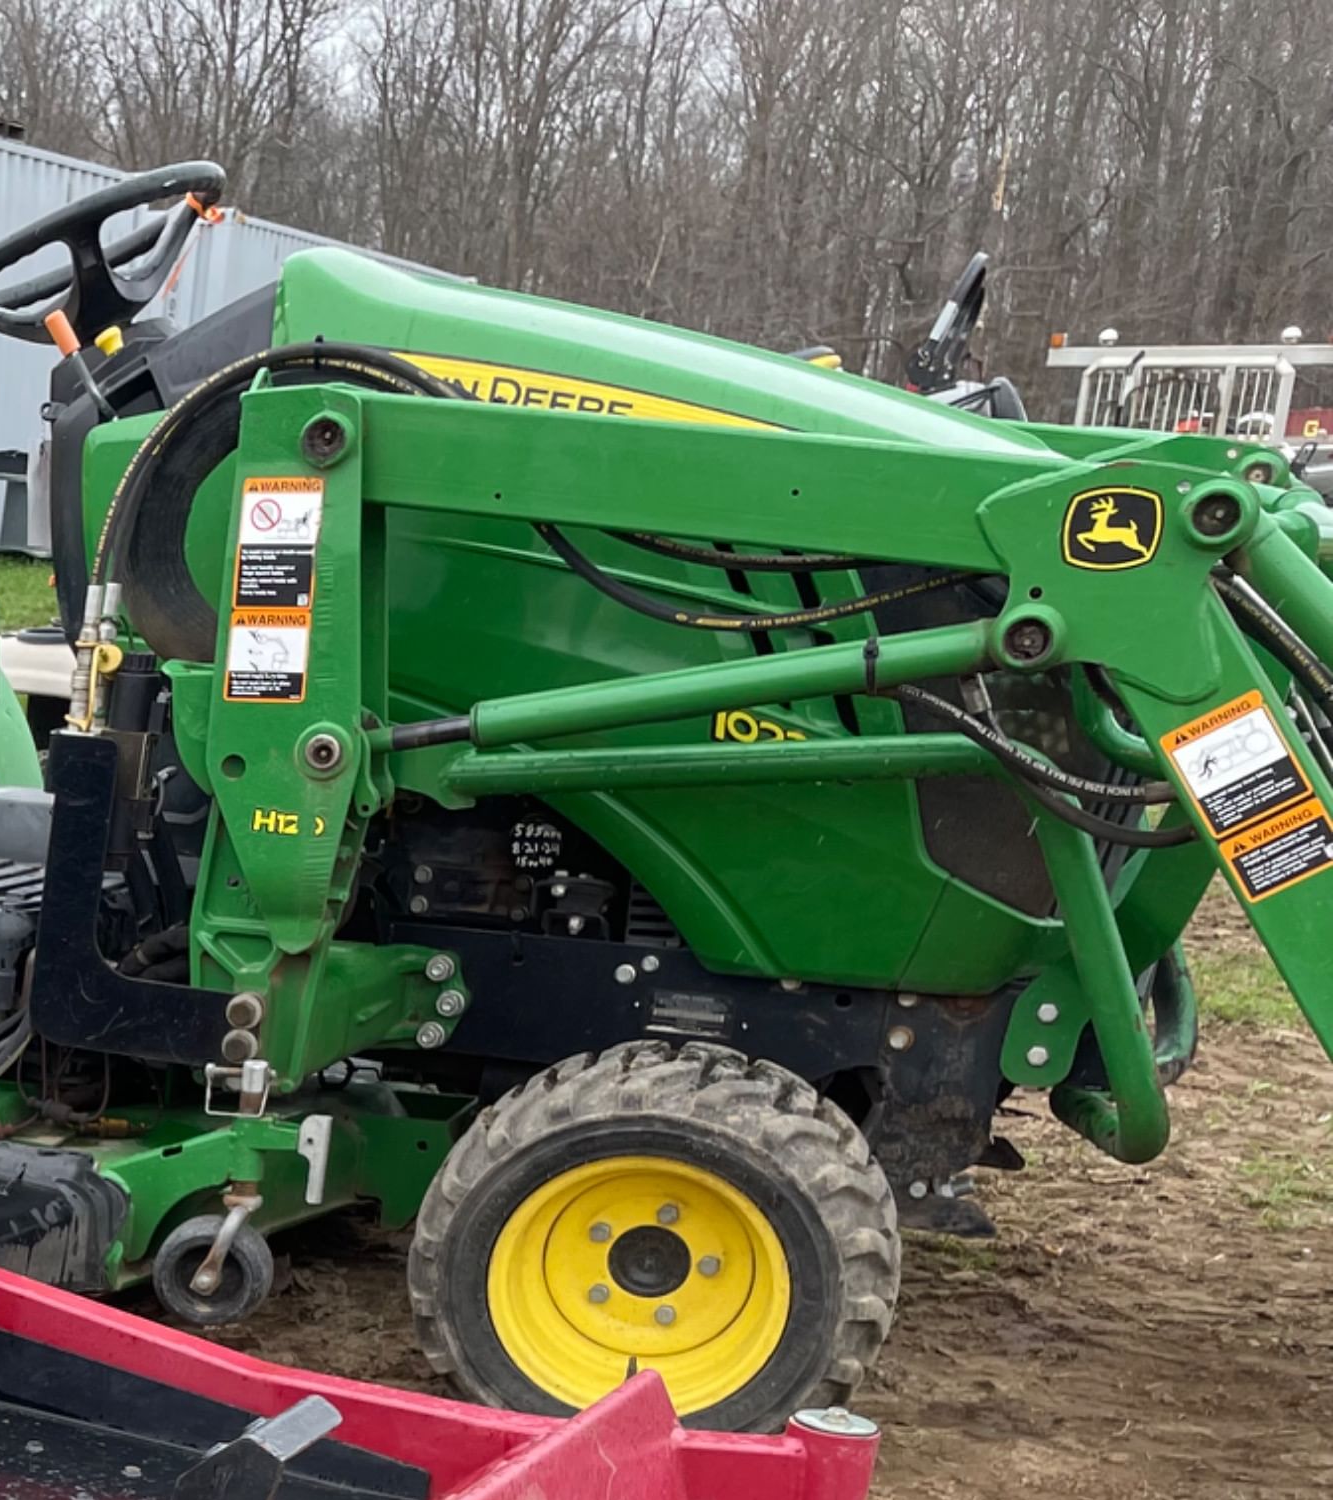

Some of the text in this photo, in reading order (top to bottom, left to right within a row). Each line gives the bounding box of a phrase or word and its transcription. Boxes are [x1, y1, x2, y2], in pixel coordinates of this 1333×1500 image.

[261, 482, 321, 492] WARNING
[246, 614, 307, 625] WARNING
[1189, 699, 1252, 737] WARNING
[1248, 808, 1314, 844] WARNING
